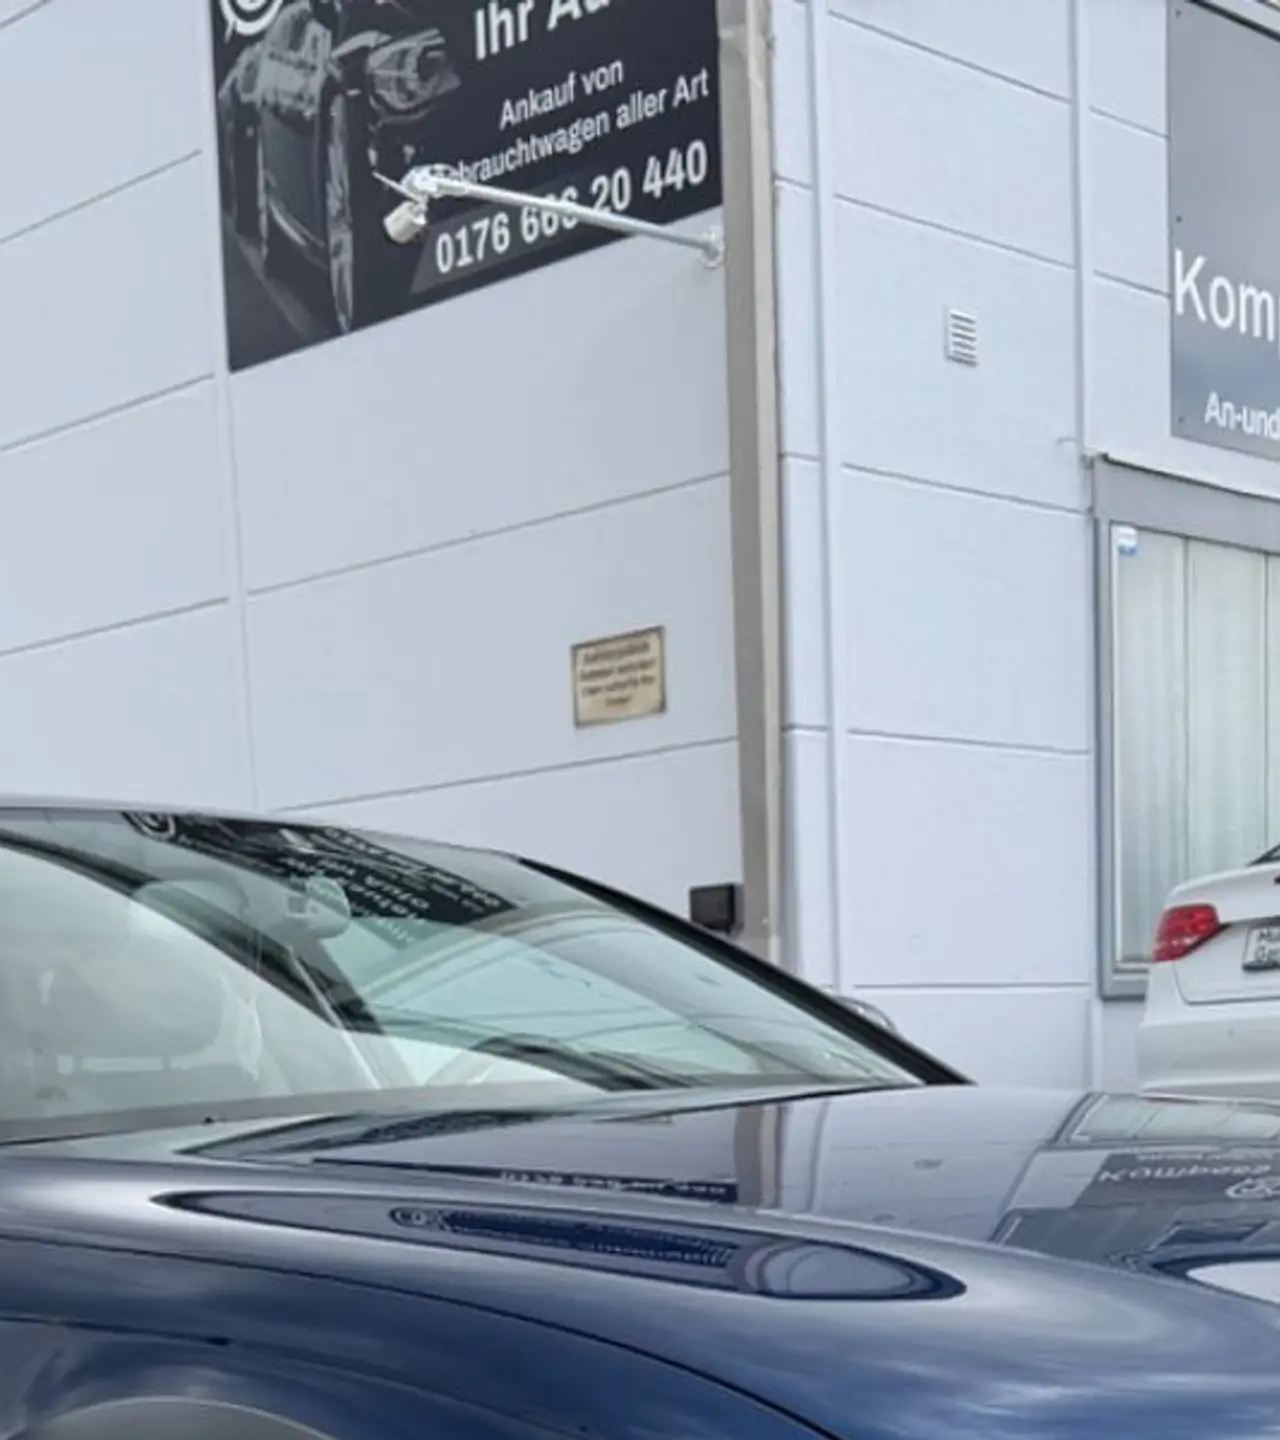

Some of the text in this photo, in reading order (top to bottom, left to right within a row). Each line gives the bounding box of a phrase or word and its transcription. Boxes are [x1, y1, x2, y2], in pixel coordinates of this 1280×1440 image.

[476, 0, 535, 61] Ihr
[500, 60, 624, 130] Ankauf von
[616, 88, 667, 129] aller
[673, 67, 710, 107] Art
[435, 210, 511, 275] 0176
[590, 165, 632, 215] 20
[642, 138, 708, 199] 440
